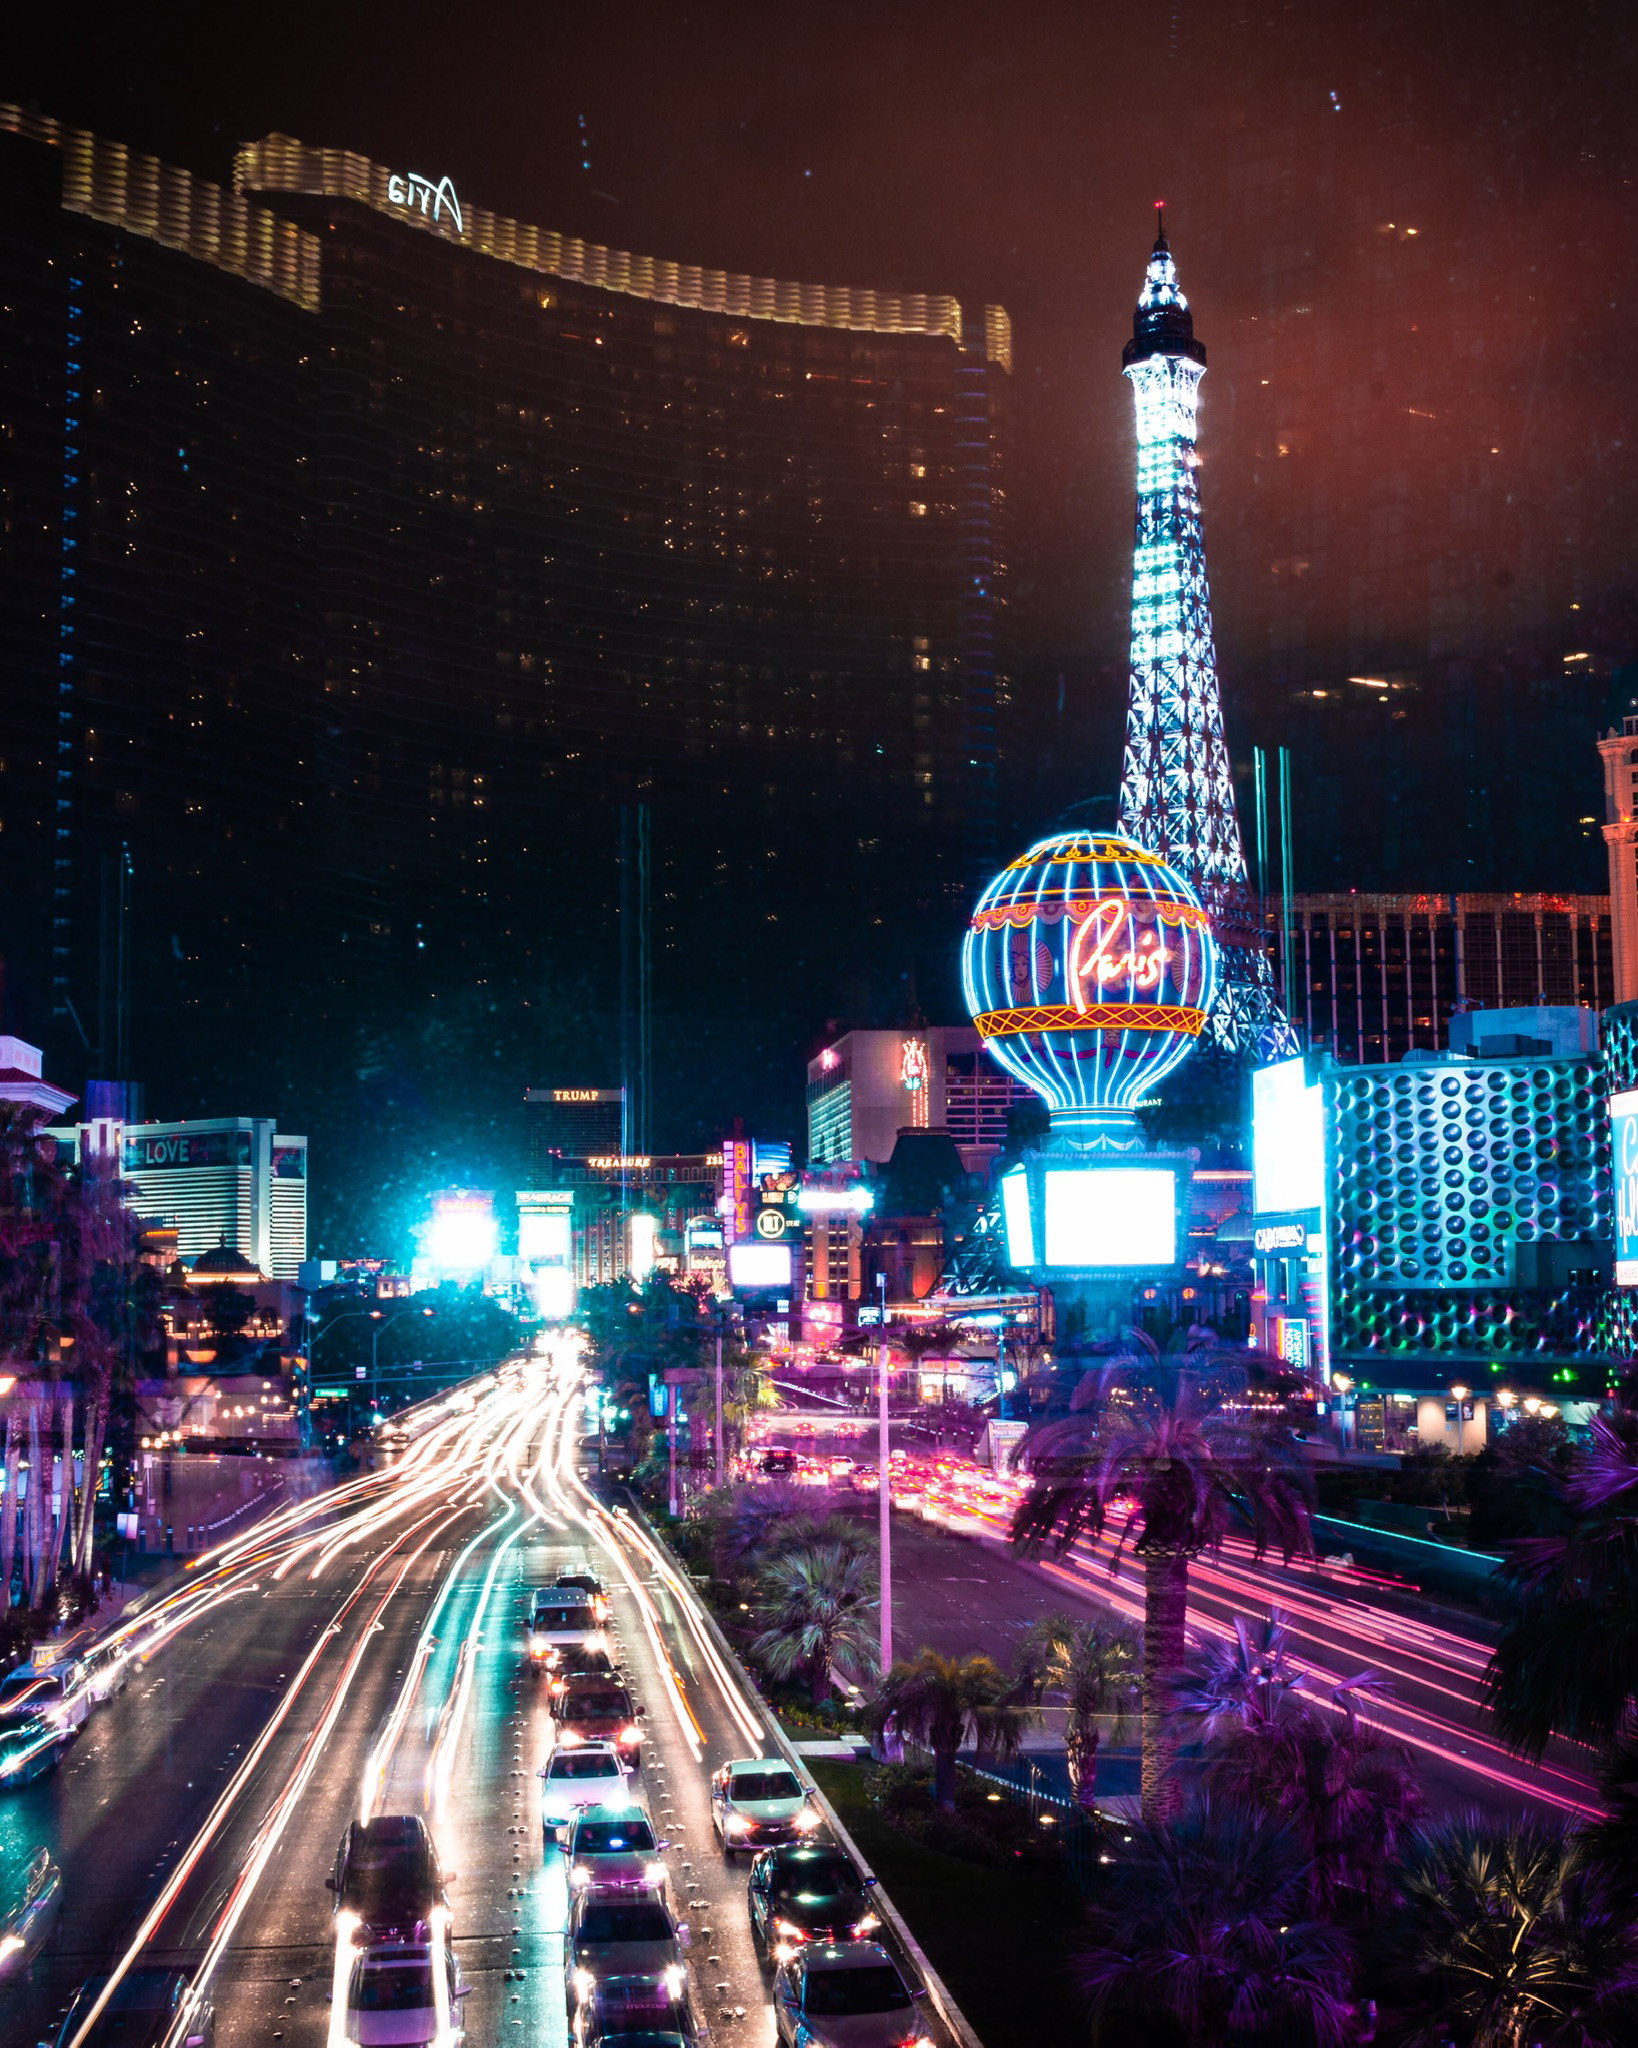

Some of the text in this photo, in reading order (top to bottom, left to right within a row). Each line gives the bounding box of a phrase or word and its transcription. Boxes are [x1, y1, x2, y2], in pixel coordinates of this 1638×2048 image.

[1071, 898, 1170, 1014] Paris
[553, 1090, 599, 1101] TRUMP
[146, 1140, 189, 1164] LOVE
[588, 1157, 651, 1169] TREASURE
[1294, 1330, 1303, 1368] RAMSAY
